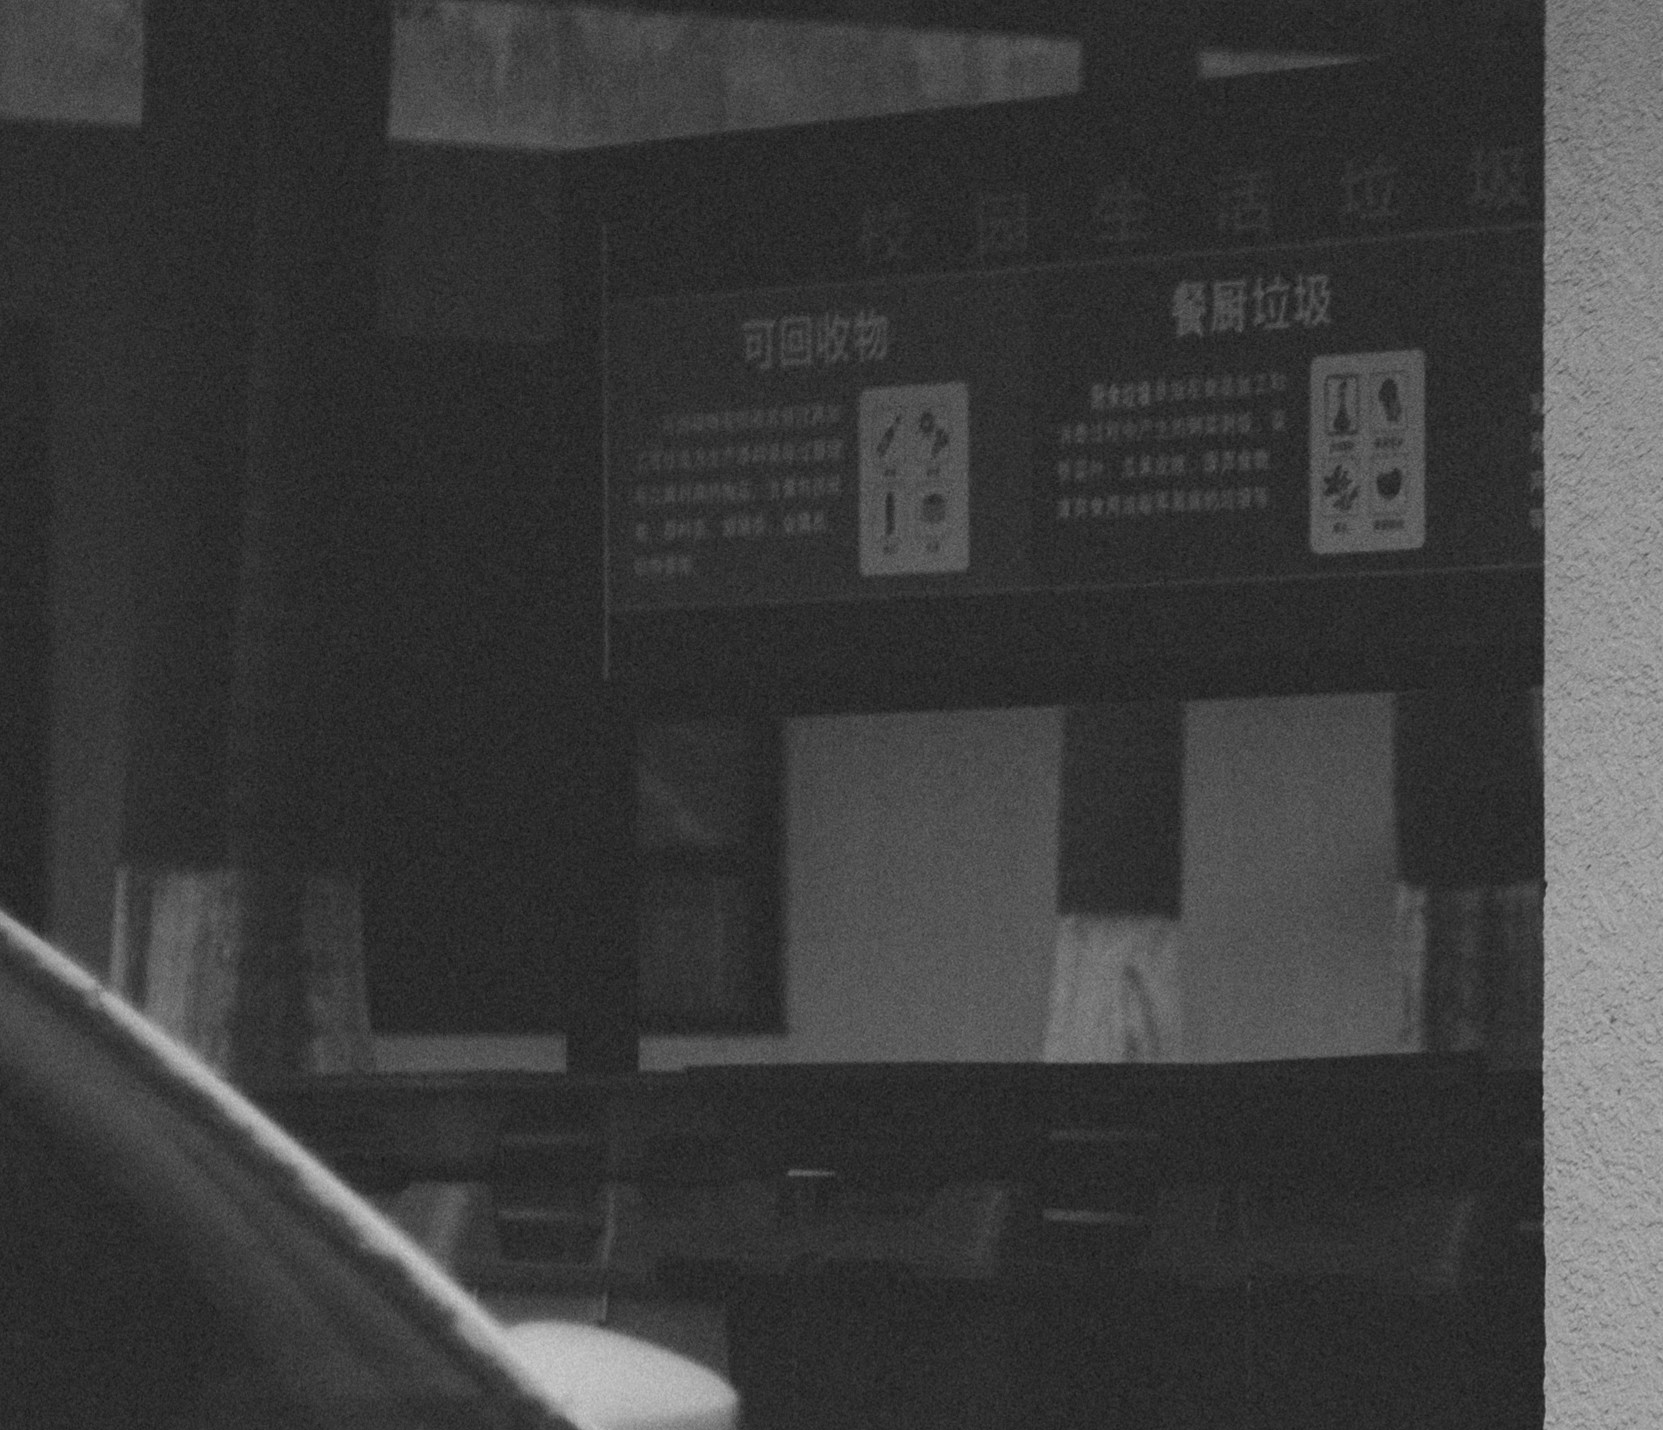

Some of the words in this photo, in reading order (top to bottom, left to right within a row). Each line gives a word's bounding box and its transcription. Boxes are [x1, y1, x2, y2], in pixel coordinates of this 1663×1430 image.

[1172, 274, 1333, 338] 餐厨垃圾
[741, 311, 888, 370] 可回收物
